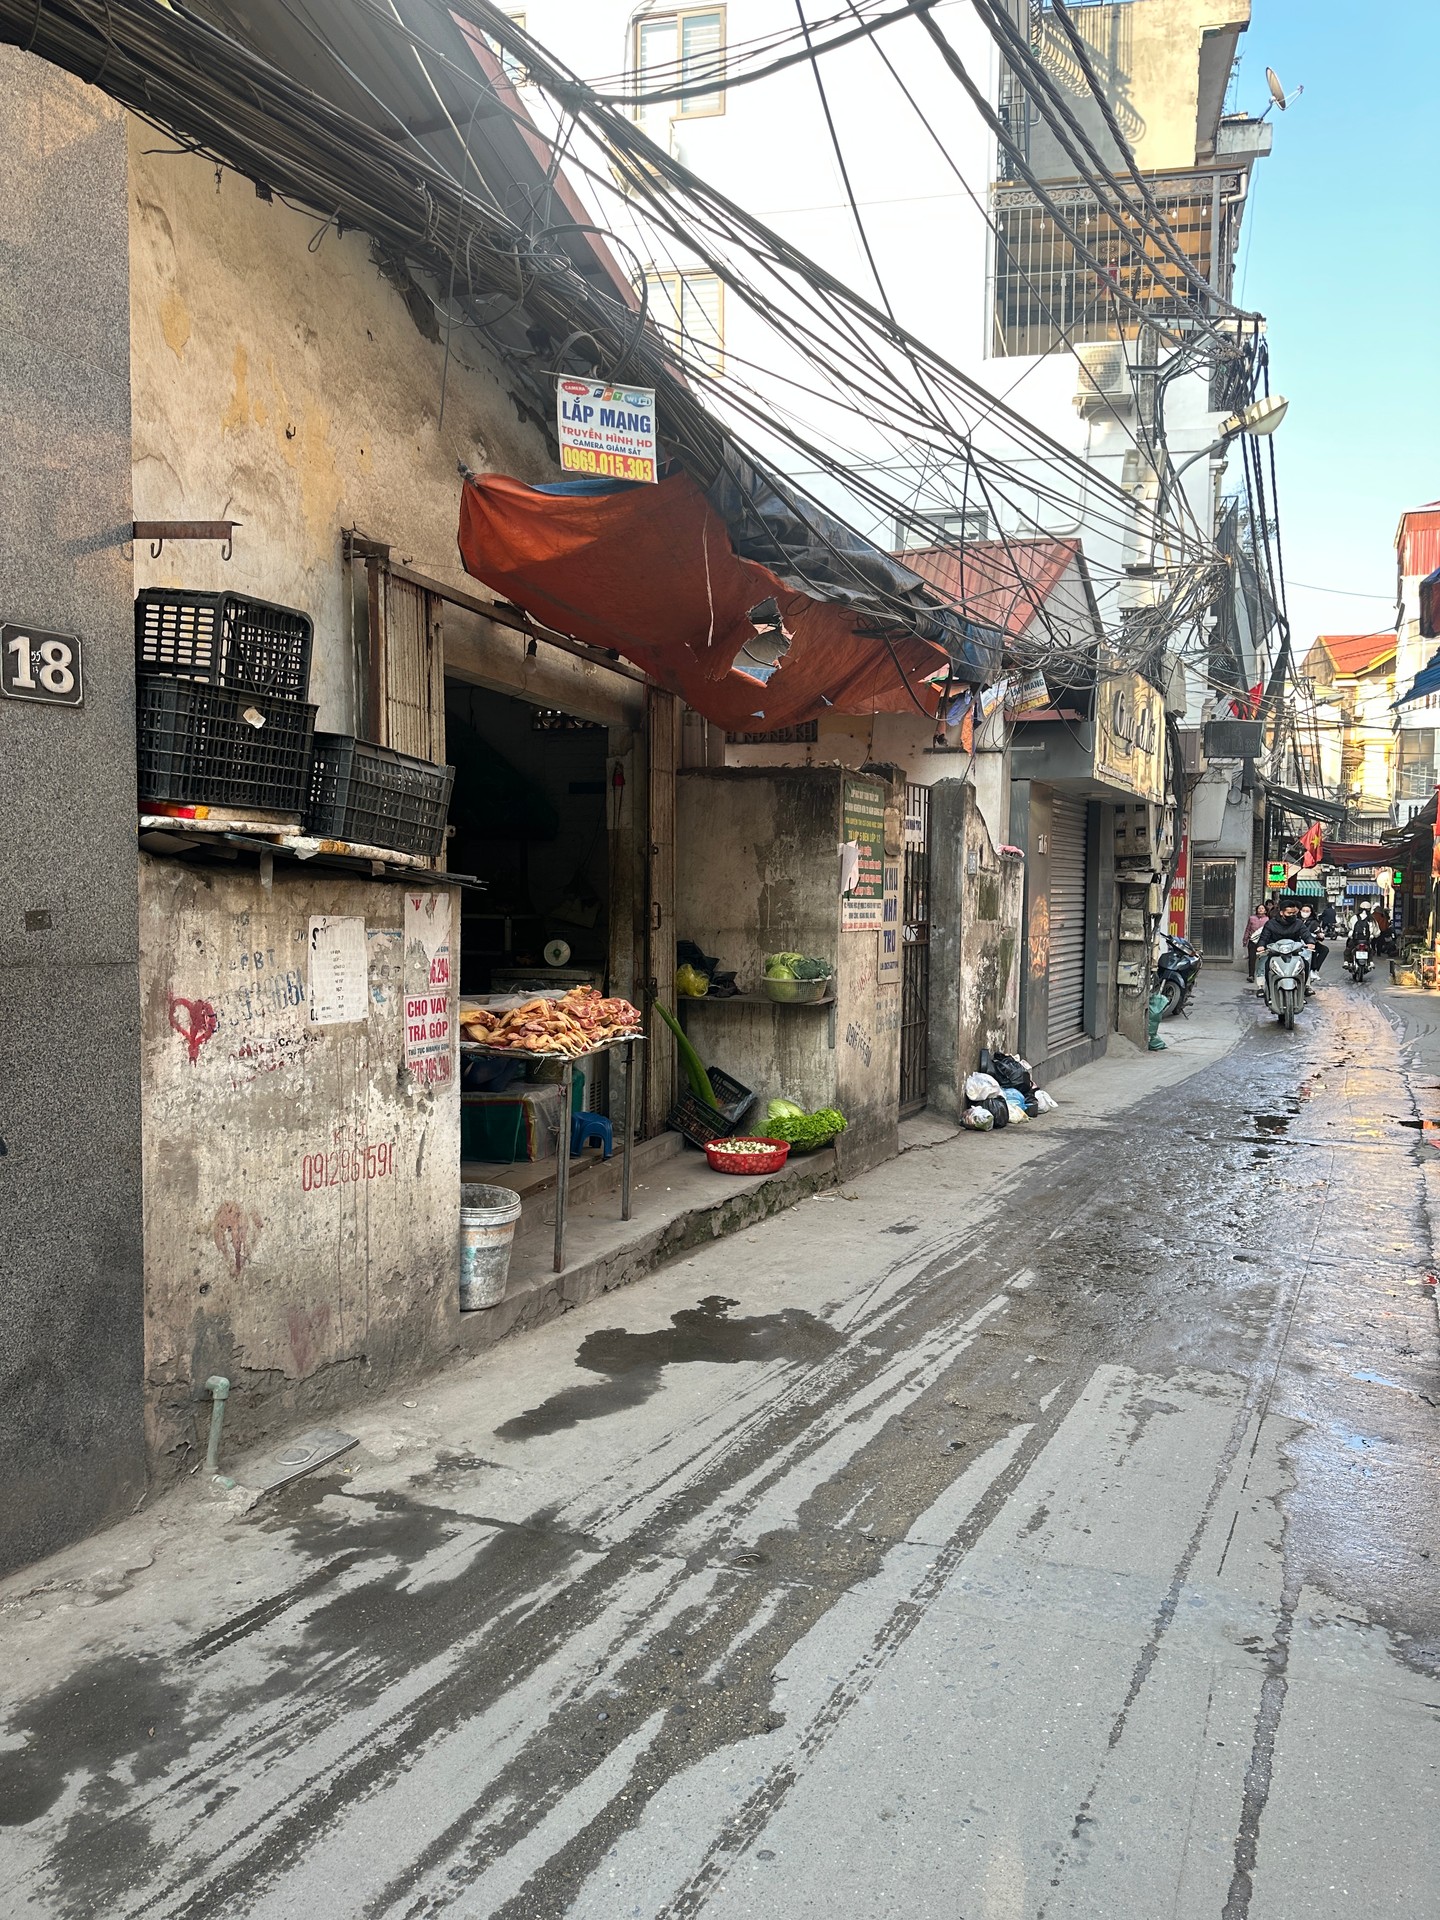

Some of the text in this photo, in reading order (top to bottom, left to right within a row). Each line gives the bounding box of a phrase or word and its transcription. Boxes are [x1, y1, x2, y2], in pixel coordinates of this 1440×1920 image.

[564, 384, 586, 392] CAMERA
[593, 387, 623, 402] FPT
[562, 397, 651, 434] LẮP MẠNG
[562, 426, 653, 448] TRUYỀN HÌNH HD
[573, 439, 642, 456] CAMERA GIÁM SÁT
[564, 447, 652, 481] 0969.015.303
[8, 636, 75, 694] 18
[1038, 834, 1048, 854] 16
[885, 868, 898, 891] KHU
[884, 895, 897, 922] NHÀ
[884, 930, 896, 955] TRỌ
[429, 958, 449, 984] 6.294
[407, 997, 447, 1018] CHO VAY
[408, 1018, 448, 1042] TRẢ GÓP
